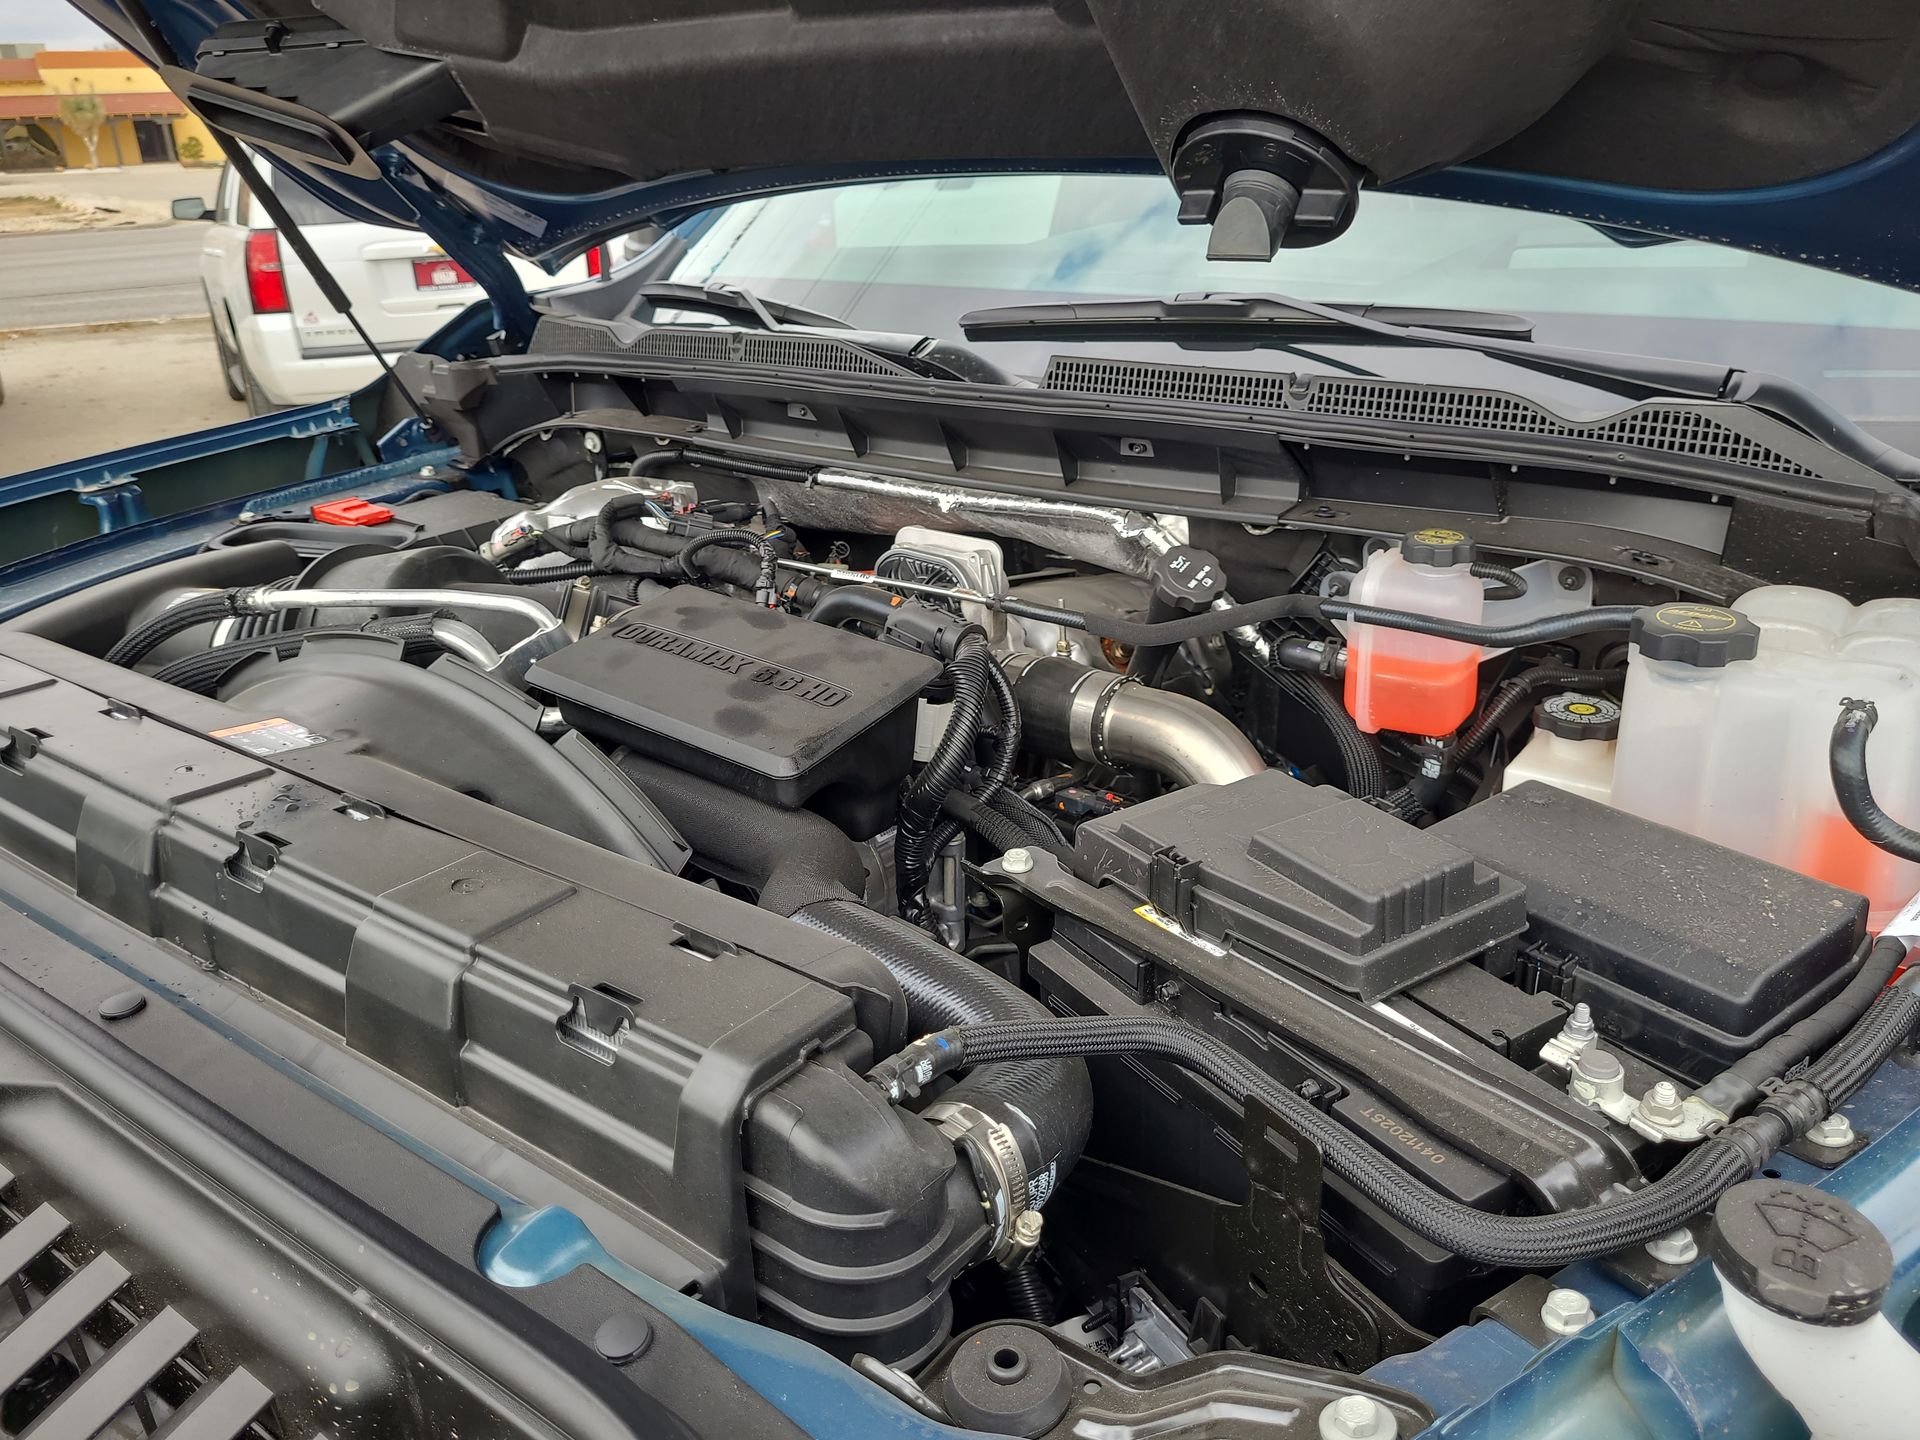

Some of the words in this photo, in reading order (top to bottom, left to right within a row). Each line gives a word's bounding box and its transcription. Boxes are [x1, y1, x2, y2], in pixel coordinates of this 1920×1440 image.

[615, 624, 752, 675] DURAMAX
[752, 667, 803, 691] 6.6
[797, 681, 849, 706] HD
[1360, 1107, 1446, 1164] 04112025T
